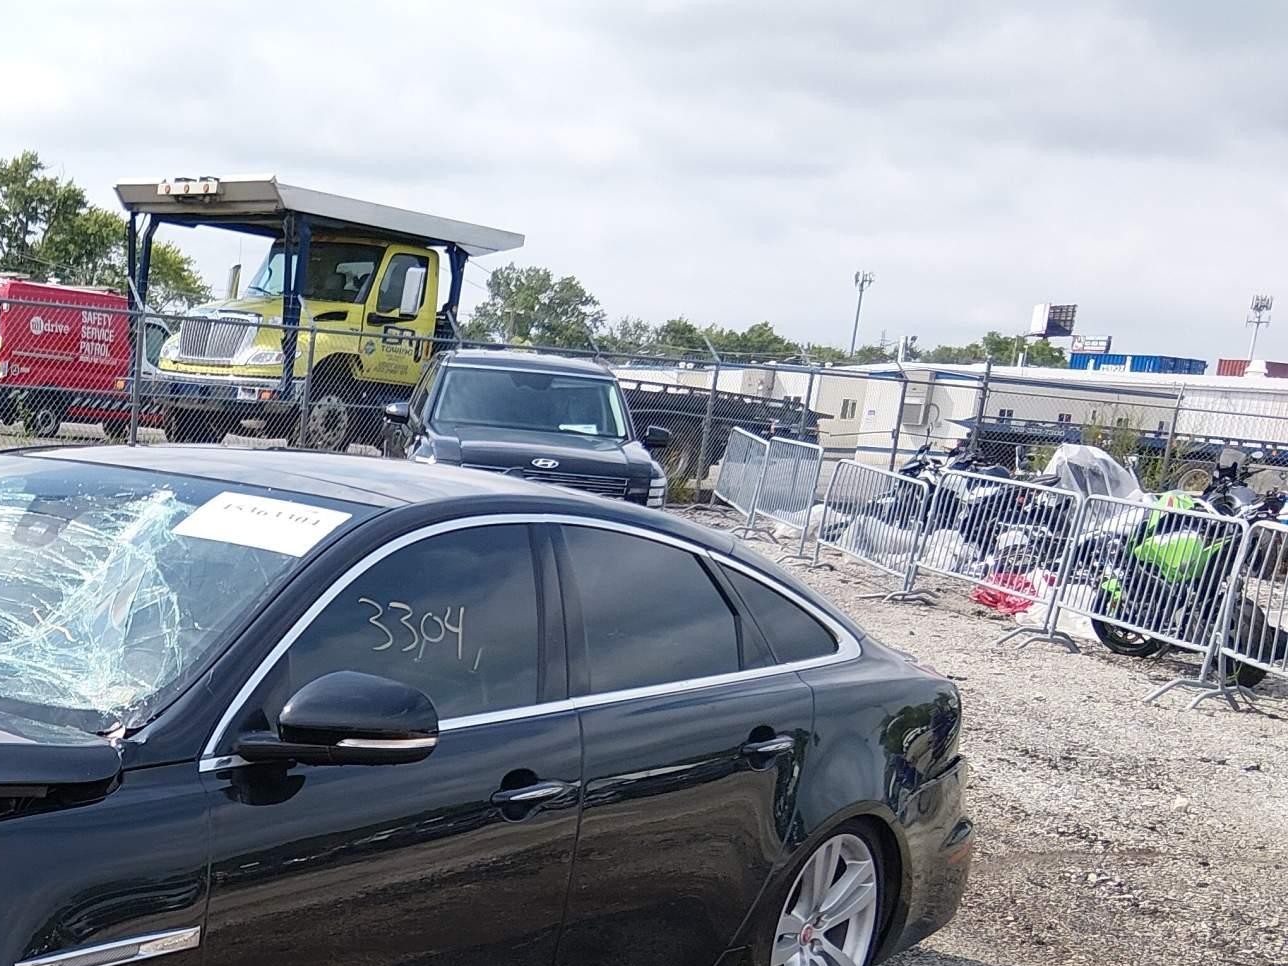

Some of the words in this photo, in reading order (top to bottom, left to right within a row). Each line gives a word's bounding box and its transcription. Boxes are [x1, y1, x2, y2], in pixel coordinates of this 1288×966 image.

[43, 320, 70, 334] drive
[81, 311, 113, 327] SAFETY
[81, 326, 115, 343] SERVICE
[80, 341, 111, 357] PATROL
